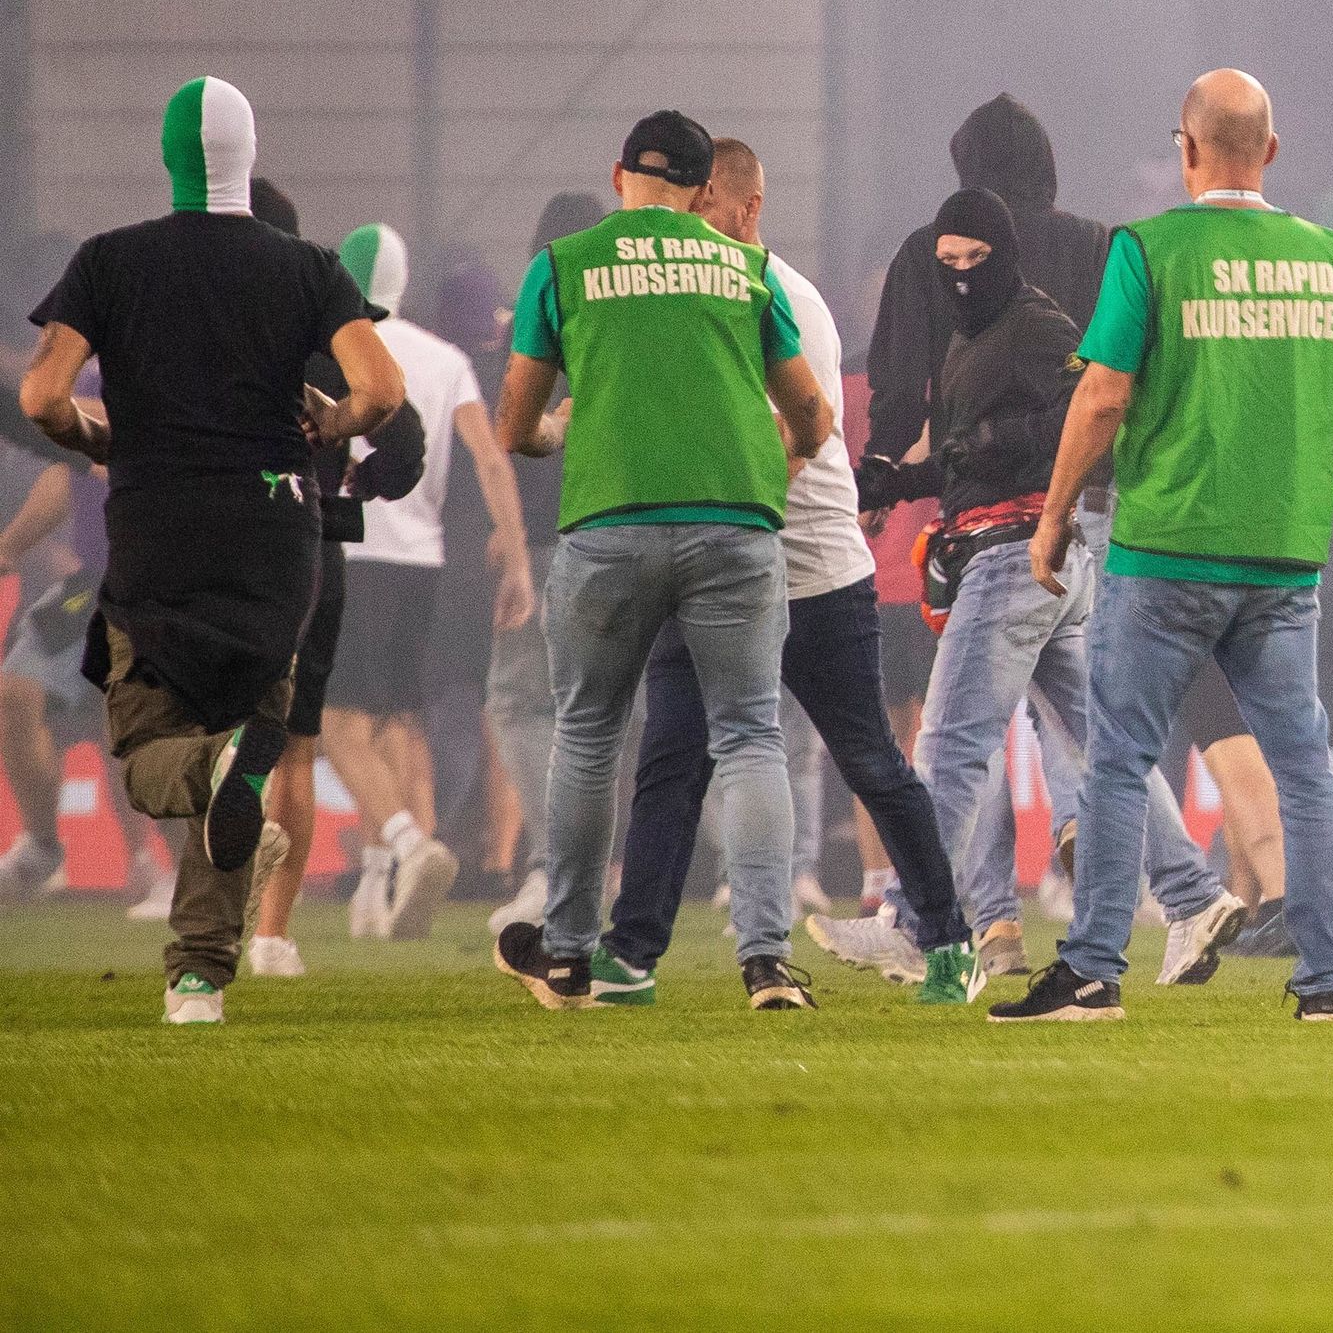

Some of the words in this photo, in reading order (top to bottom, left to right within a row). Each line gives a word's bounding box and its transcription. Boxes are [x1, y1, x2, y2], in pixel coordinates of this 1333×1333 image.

[615, 237, 657, 261] SK
[662, 237, 747, 270] RAPID
[582, 263, 752, 302] KLUBSERVICE
[1211, 259, 1251, 294] SK
